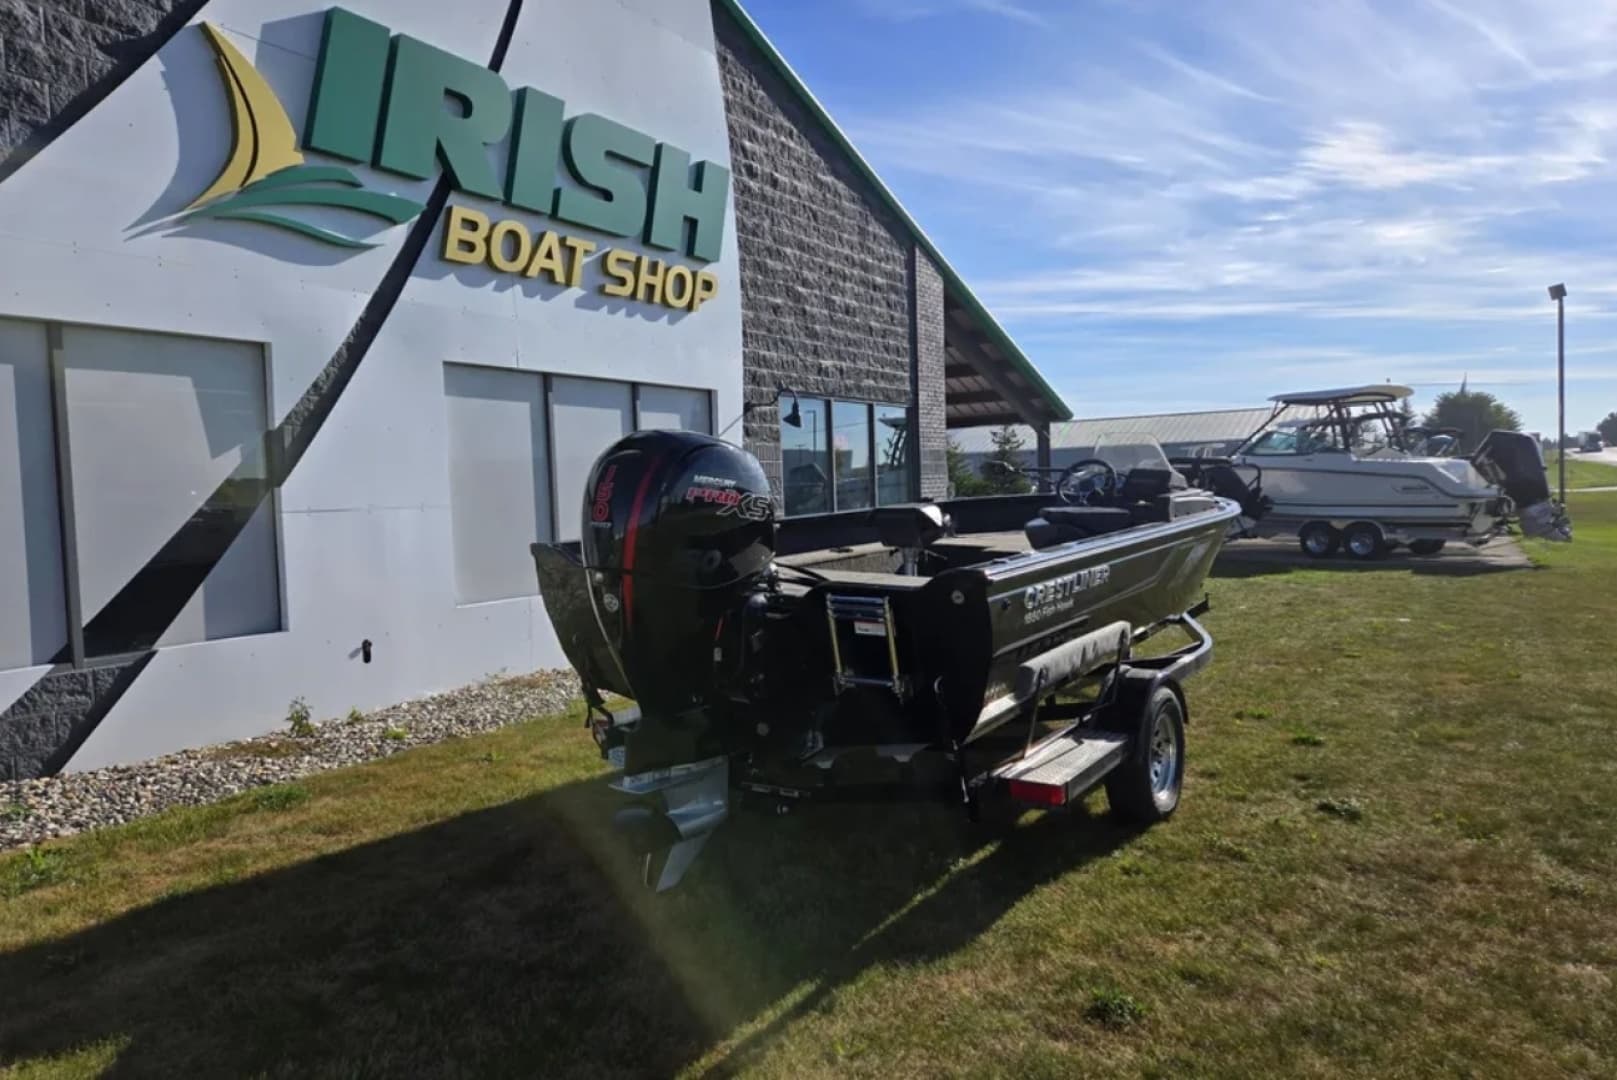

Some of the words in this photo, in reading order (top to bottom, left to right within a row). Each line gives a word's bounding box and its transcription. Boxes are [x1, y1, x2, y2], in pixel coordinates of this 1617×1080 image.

[302, 6, 730, 263] IRISH
[443, 205, 596, 288] BOAT
[601, 248, 719, 313] SHOP
[1024, 564, 1110, 609] CRESTLINER
